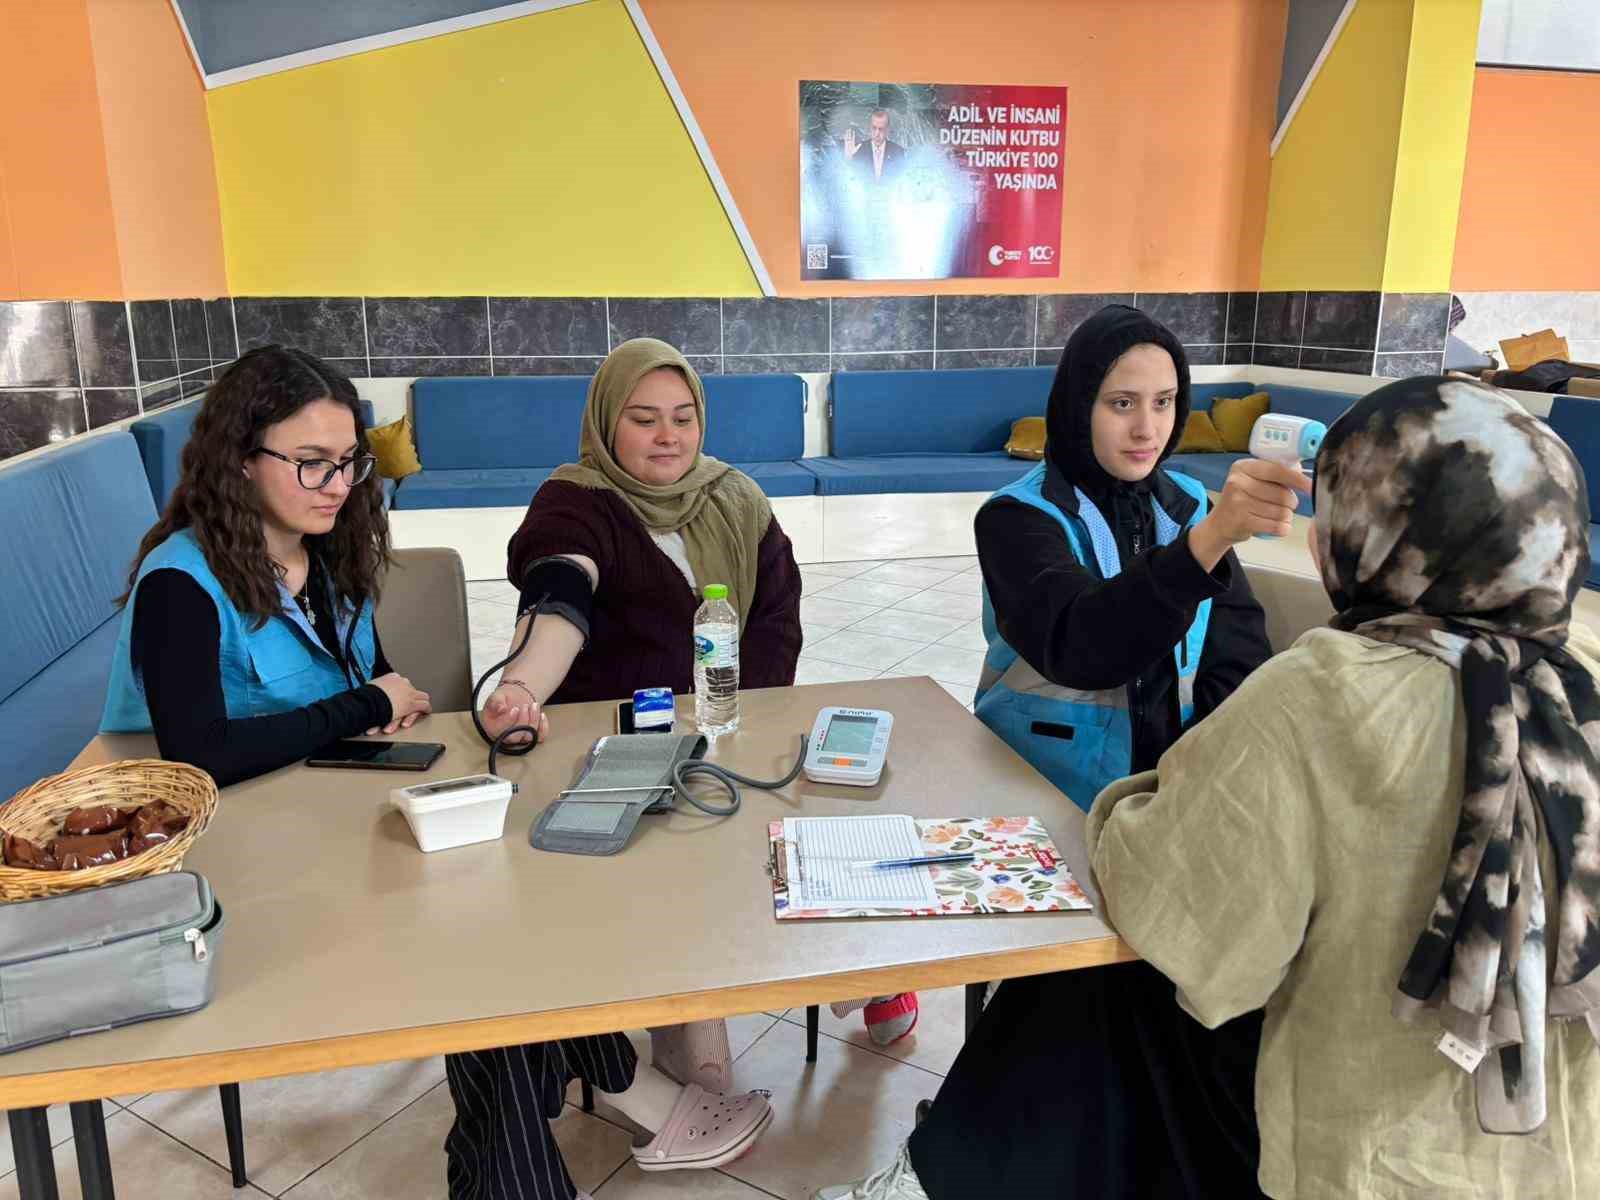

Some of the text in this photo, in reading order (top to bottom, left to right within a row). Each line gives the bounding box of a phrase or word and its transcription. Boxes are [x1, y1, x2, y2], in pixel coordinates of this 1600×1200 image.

[948, 103, 1060, 124] ADİL VE İNSANİ
[940, 126, 1059, 146] DÜZENİN KUTBU
[966, 148, 1058, 168] TÜRKİYE 100
[994, 174, 1057, 192] YAŞINDA
